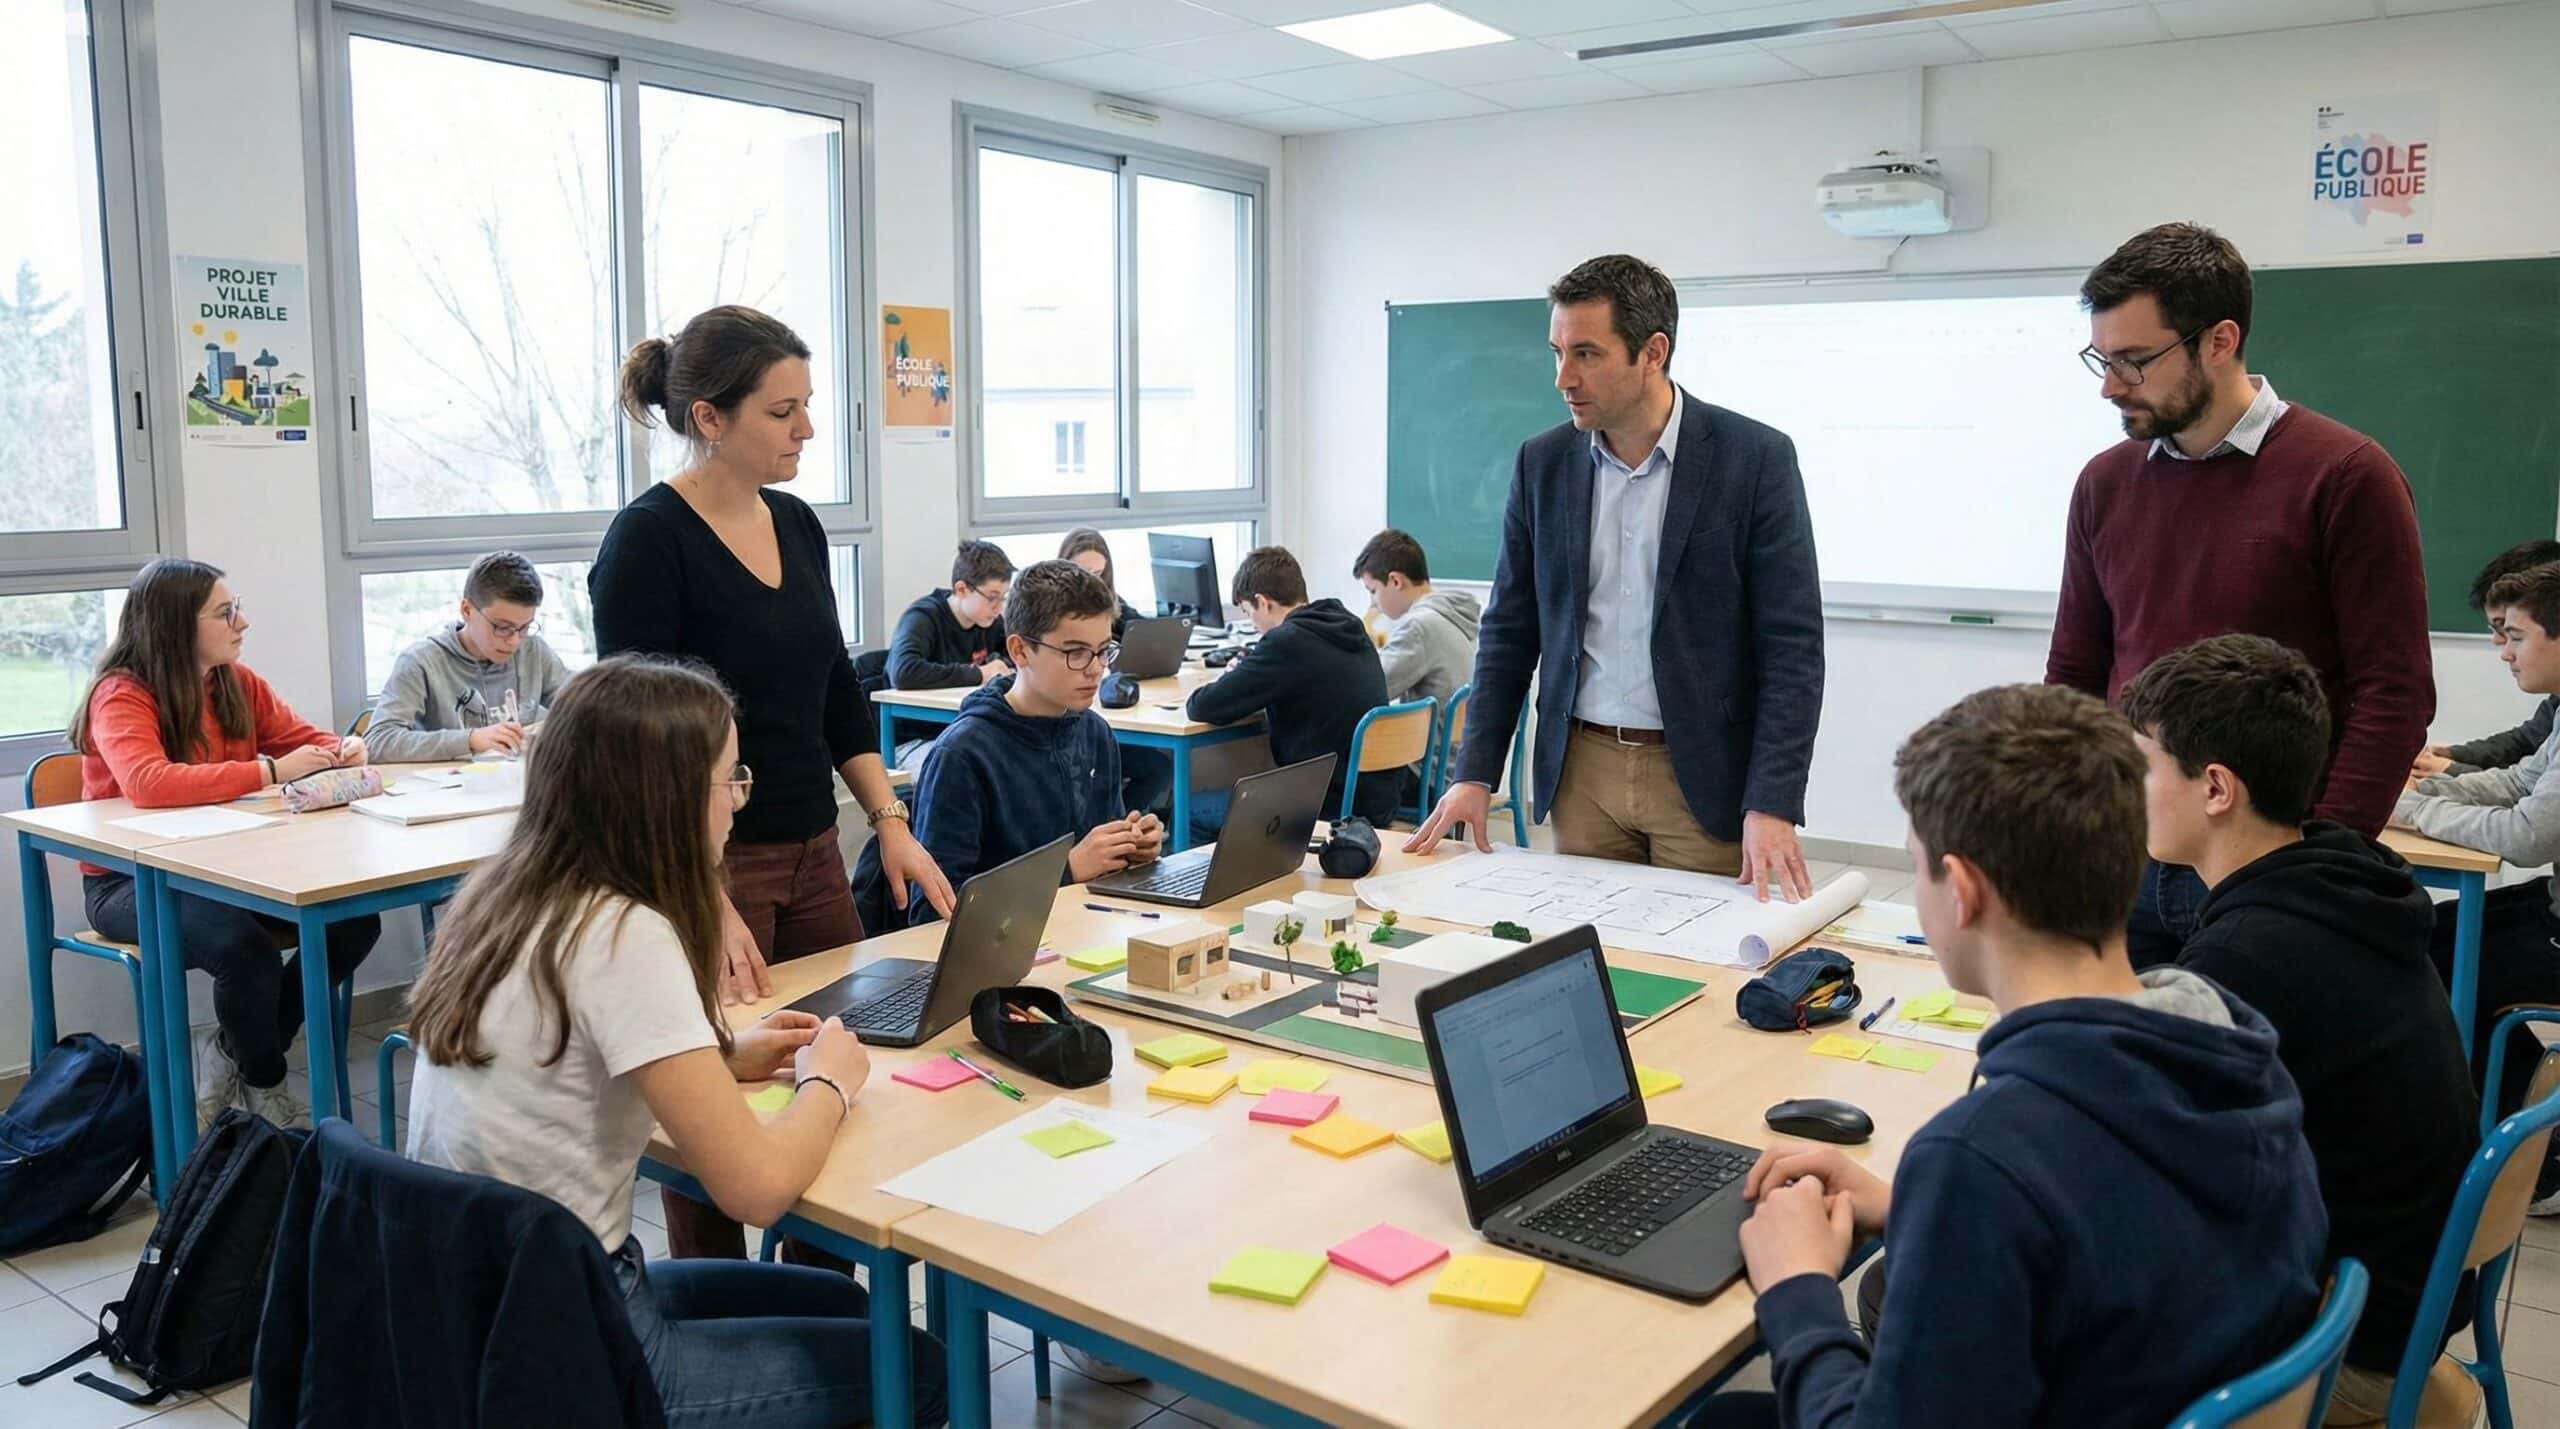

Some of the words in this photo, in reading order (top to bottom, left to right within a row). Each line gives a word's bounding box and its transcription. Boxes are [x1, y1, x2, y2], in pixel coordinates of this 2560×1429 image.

[2315, 143, 2428, 179] ÉCOLE
[2314, 176, 2426, 200] PUBLIQUE
[207, 268, 278, 286] PROJET
[216, 286, 270, 303] VILLE
[201, 303, 288, 321] DURABLE
[896, 374, 951, 389] PUBLIQUE
